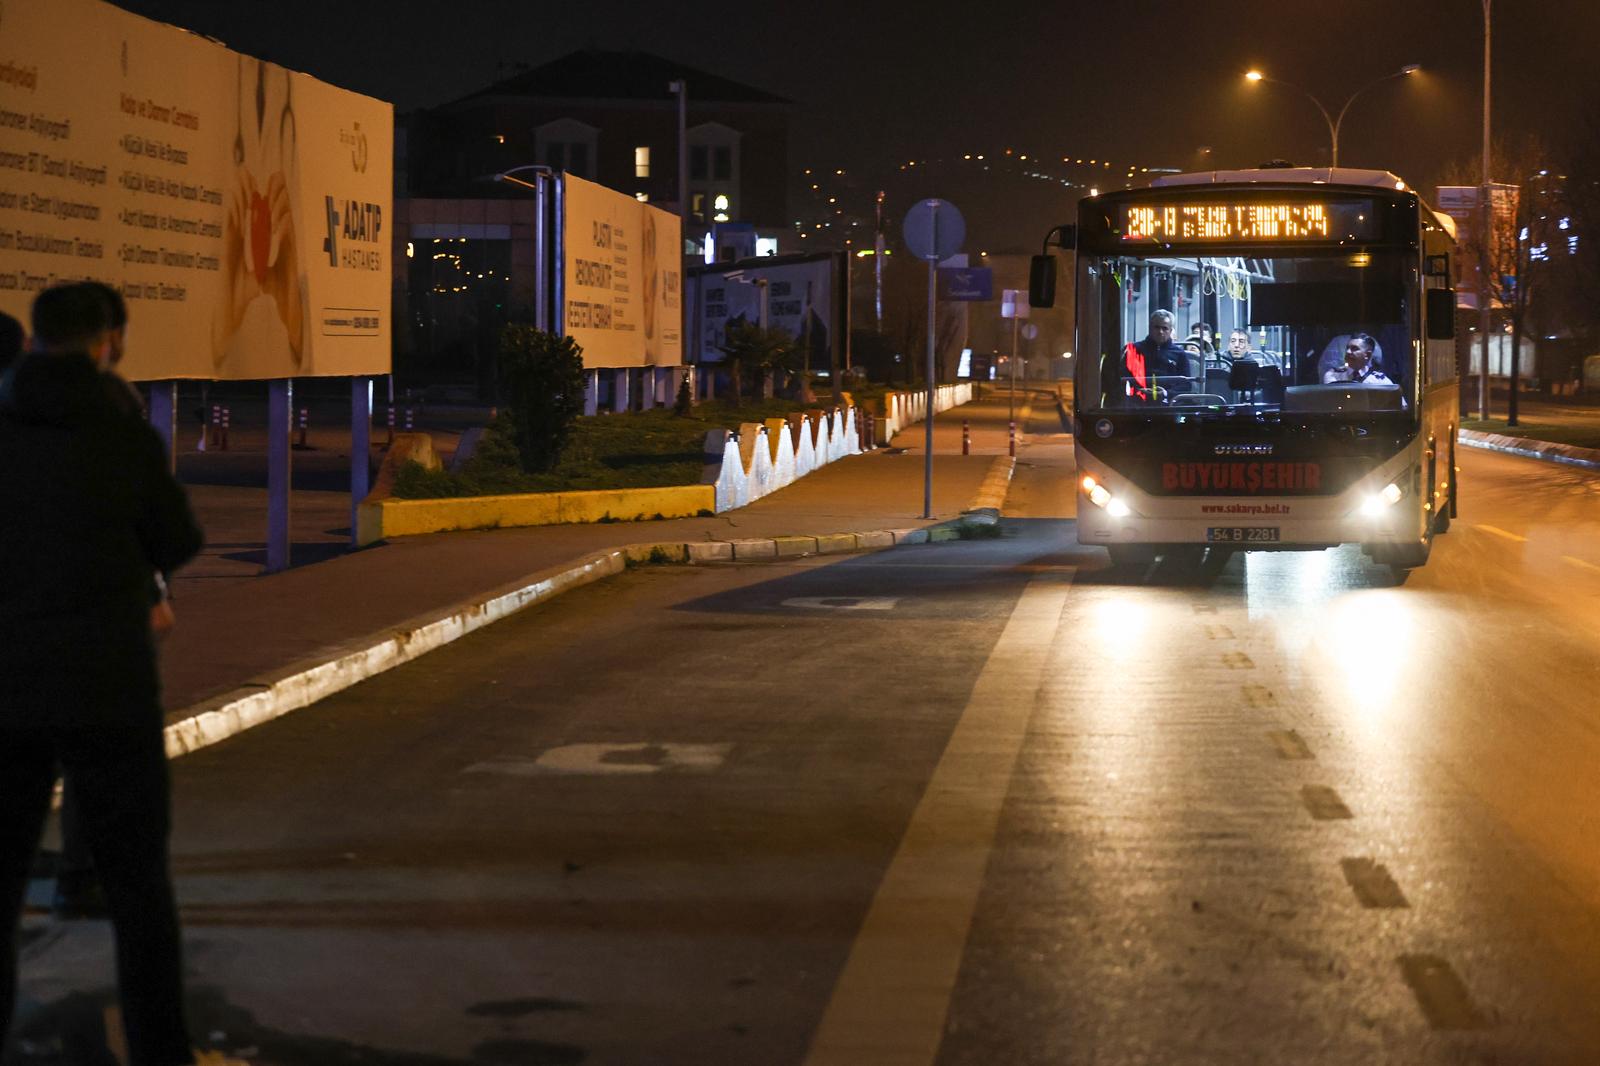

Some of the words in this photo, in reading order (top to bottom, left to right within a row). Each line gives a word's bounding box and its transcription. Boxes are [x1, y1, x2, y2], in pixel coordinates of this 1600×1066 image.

[343, 199, 382, 244] ADATIP
[1162, 462, 1320, 494] BÜYÜKŞEHİR
[1202, 503, 1290, 515] www.sakarya.bel.tr
[1213, 528, 1228, 541] 54
[1233, 528, 1243, 541] B
[1247, 528, 1276, 541] 2281
